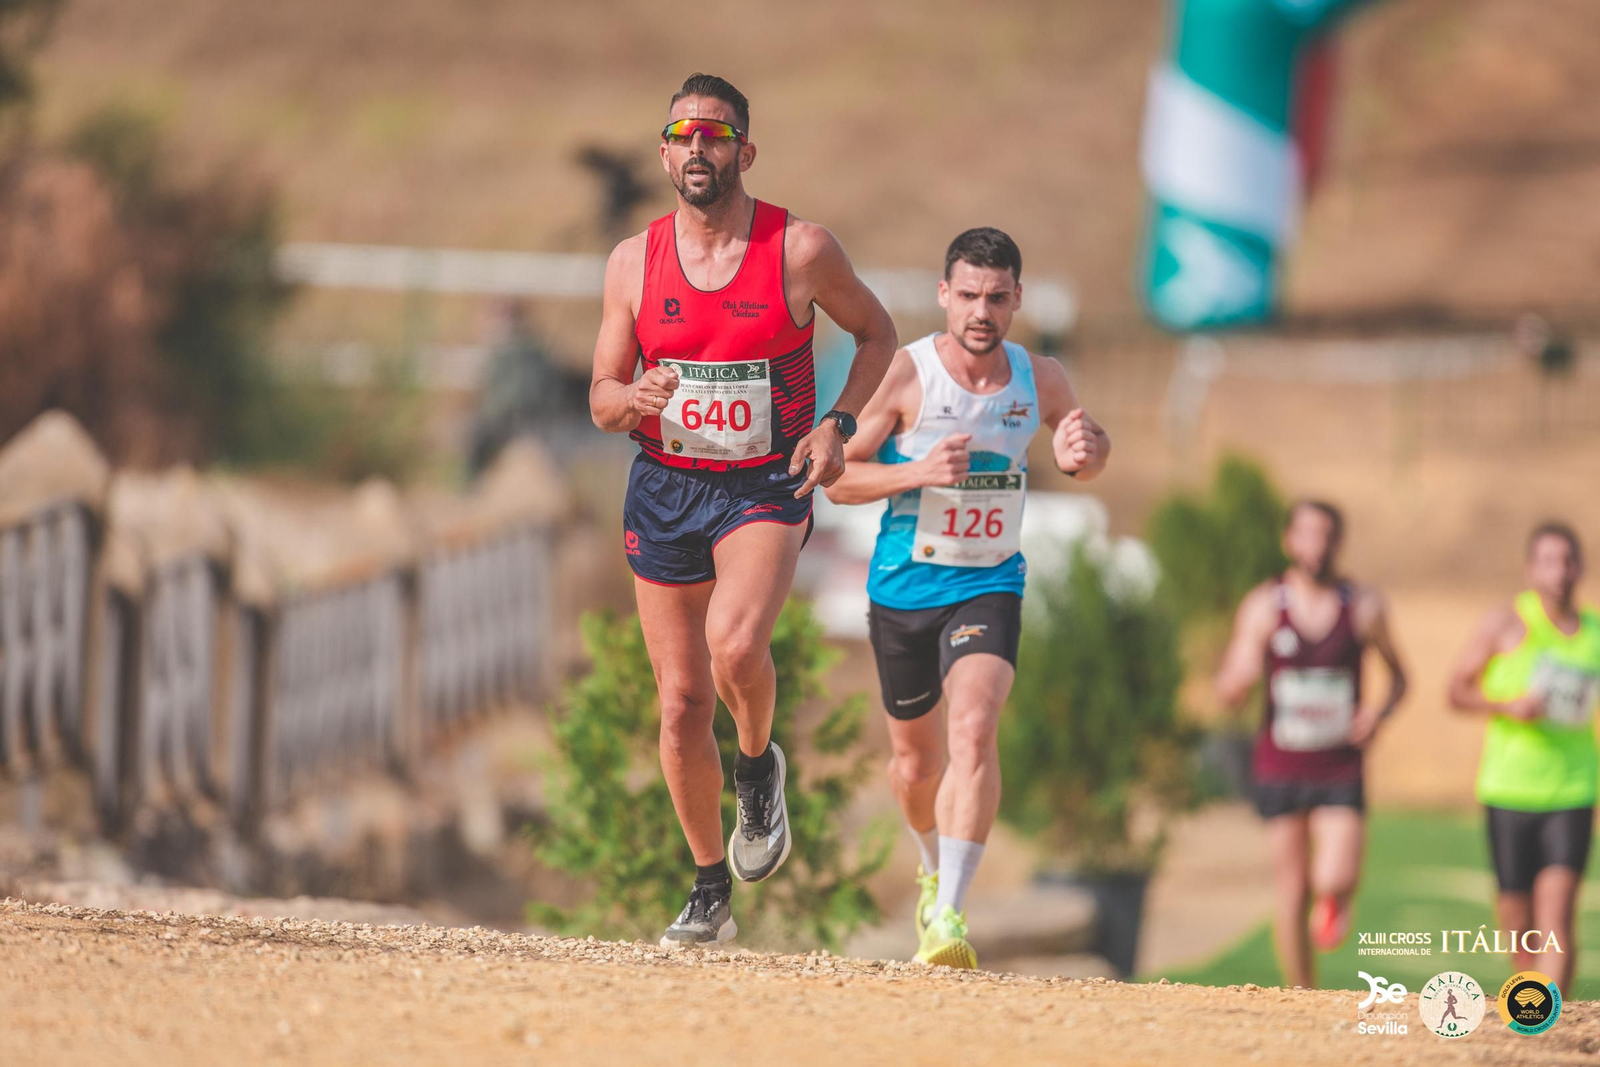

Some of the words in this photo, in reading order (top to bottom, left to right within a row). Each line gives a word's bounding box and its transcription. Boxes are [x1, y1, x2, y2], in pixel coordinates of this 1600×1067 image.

[689, 366, 738, 378] ITÁLICA
[681, 398, 752, 432] 640
[941, 507, 1004, 539] 126
